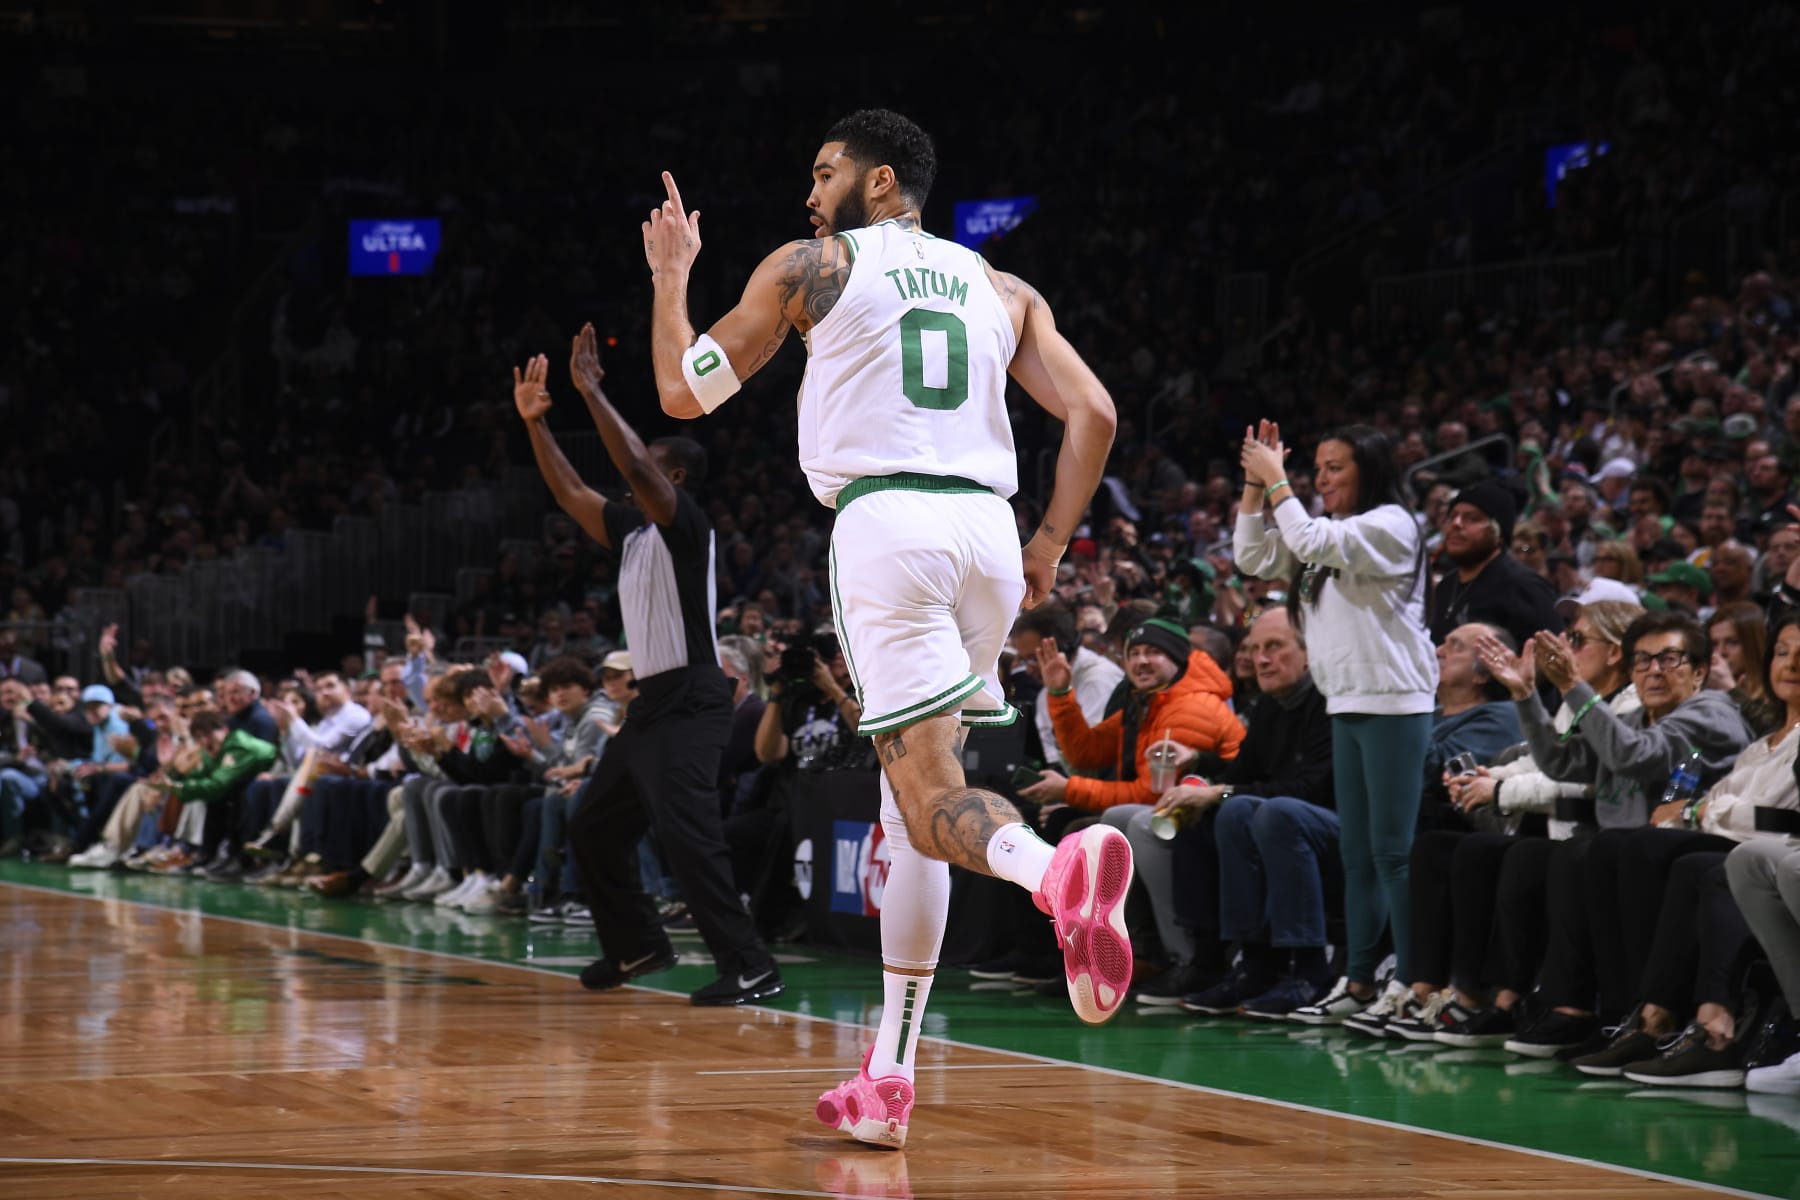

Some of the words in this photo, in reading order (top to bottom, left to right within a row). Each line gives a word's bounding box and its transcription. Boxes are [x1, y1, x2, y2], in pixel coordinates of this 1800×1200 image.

[361, 233, 427, 253] ULTRA
[885, 267, 969, 307] TATUM
[693, 350, 721, 376] 0
[900, 308, 969, 410] 0
